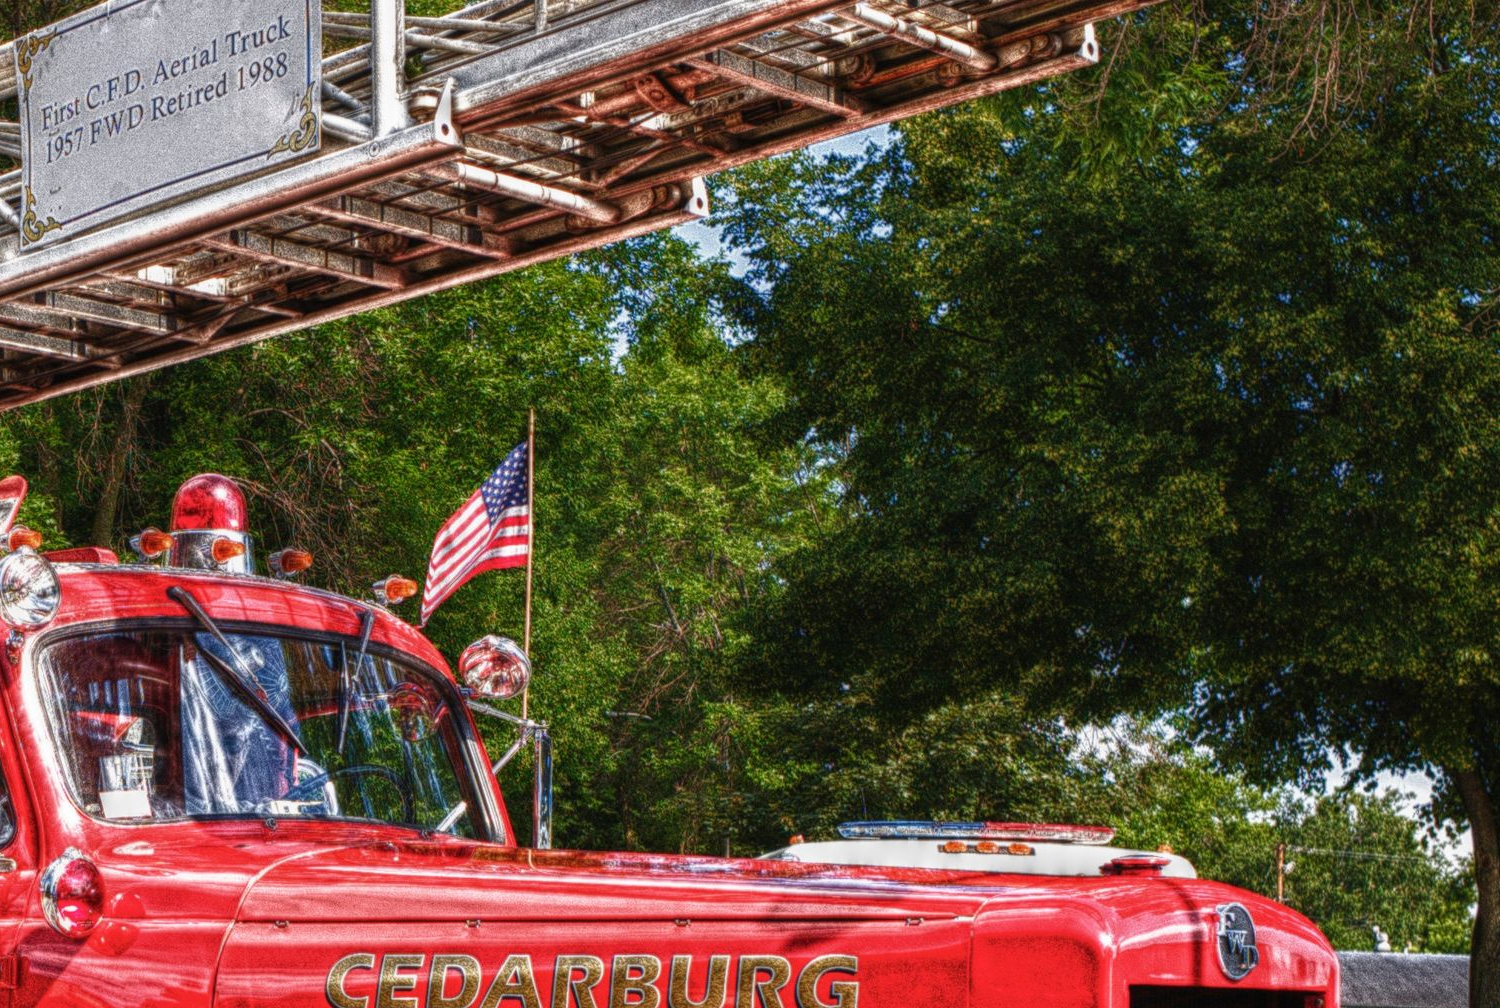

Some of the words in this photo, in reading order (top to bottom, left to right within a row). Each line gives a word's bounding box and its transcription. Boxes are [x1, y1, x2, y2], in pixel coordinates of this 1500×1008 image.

[41, 96, 81, 132] First
[86, 68, 145, 112] C.F.D.
[152, 40, 219, 86] Aerial
[225, 14, 291, 58] Truck
[45, 126, 85, 164] 1957
[90, 103, 145, 146] FWD
[150, 71, 229, 122] Retired
[237, 51, 289, 91] 1988
